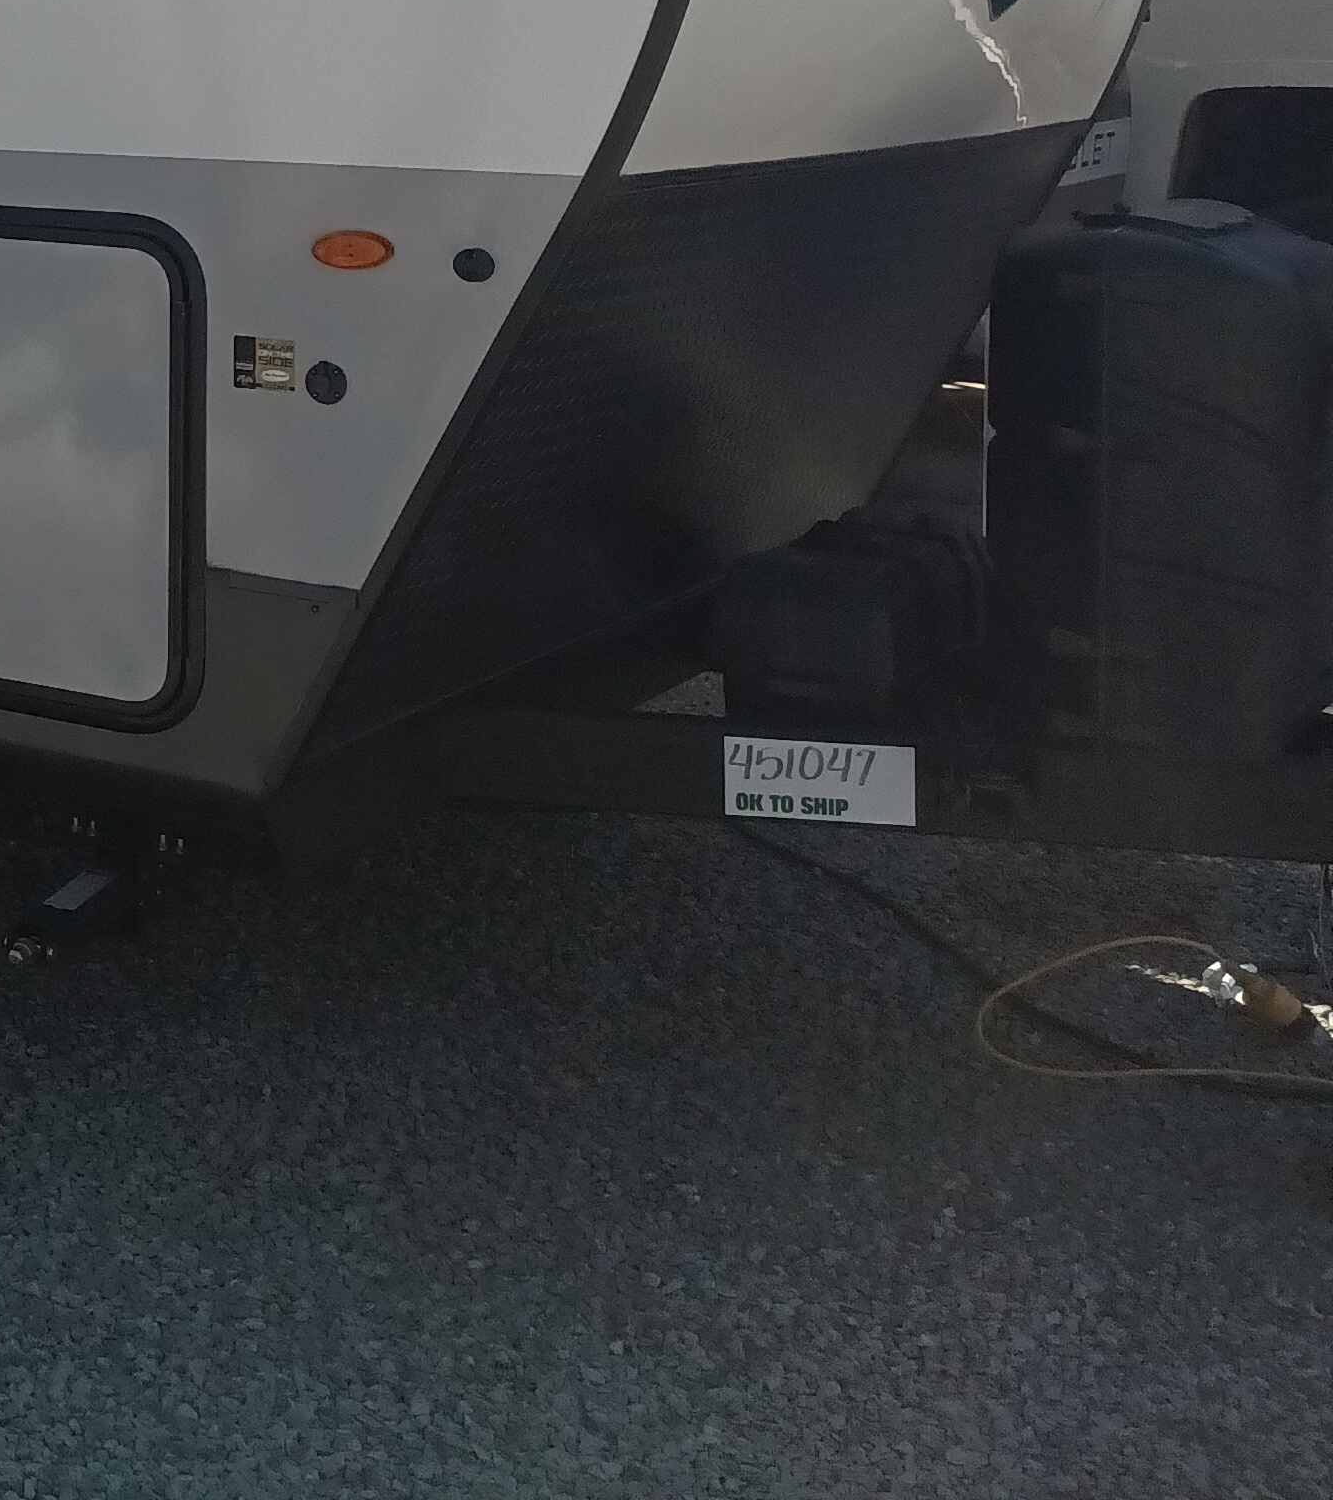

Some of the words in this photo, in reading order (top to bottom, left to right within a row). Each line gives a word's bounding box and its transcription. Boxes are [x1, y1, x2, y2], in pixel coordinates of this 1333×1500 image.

[258, 355, 293, 368] SIDE
[729, 744, 877, 786] 451047
[736, 792, 764, 811] OK
[769, 795, 794, 814] TO
[800, 796, 849, 817] SHIP
